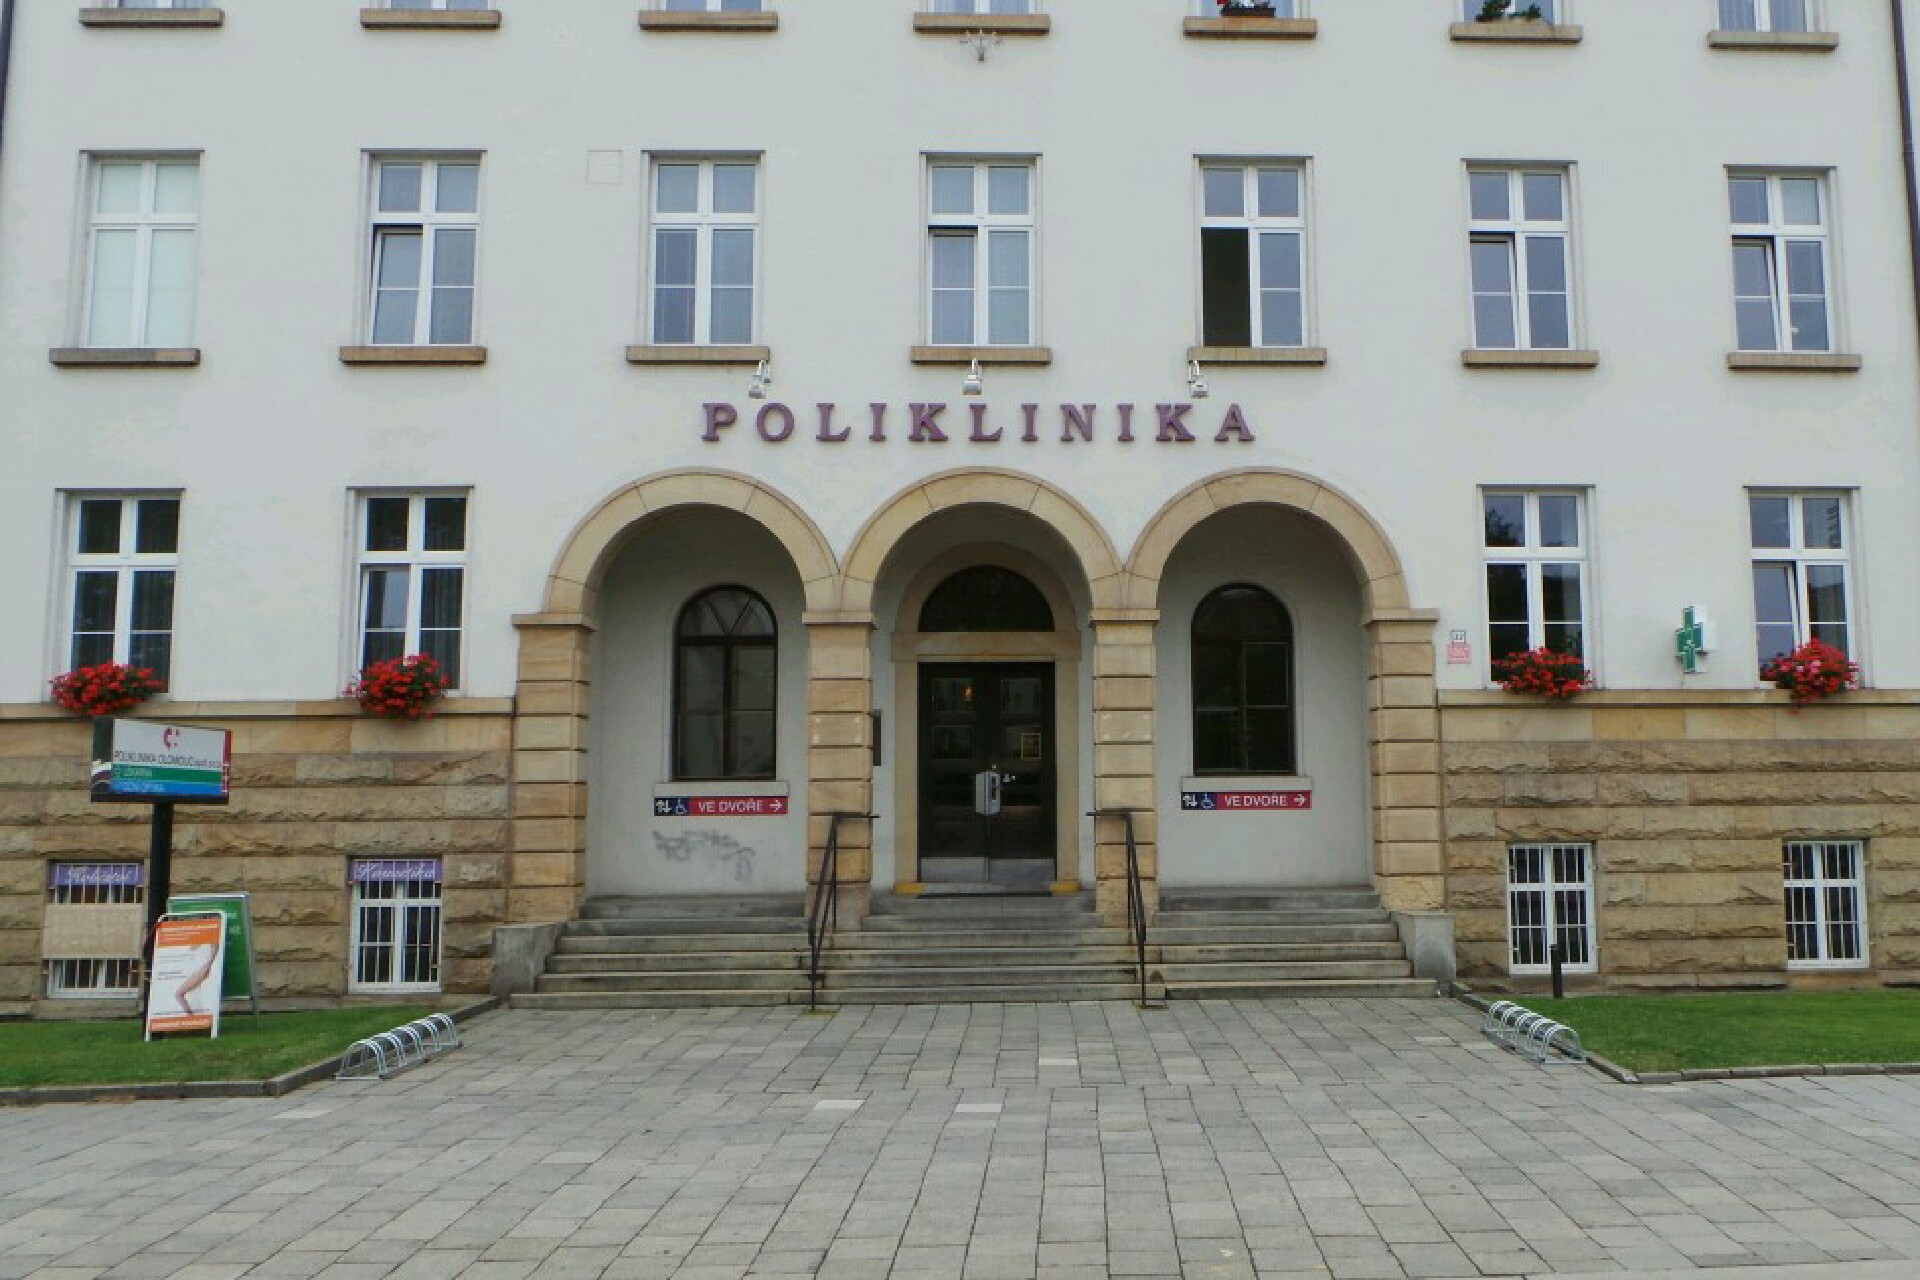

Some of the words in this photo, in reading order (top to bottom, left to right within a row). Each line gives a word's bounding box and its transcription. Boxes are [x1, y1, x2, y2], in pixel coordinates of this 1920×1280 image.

[701, 402, 1255, 442] POLIKLINIKA
[698, 800, 715, 812] VE
[719, 798, 763, 812] DVOŘE
[1225, 795, 1241, 807] VE
